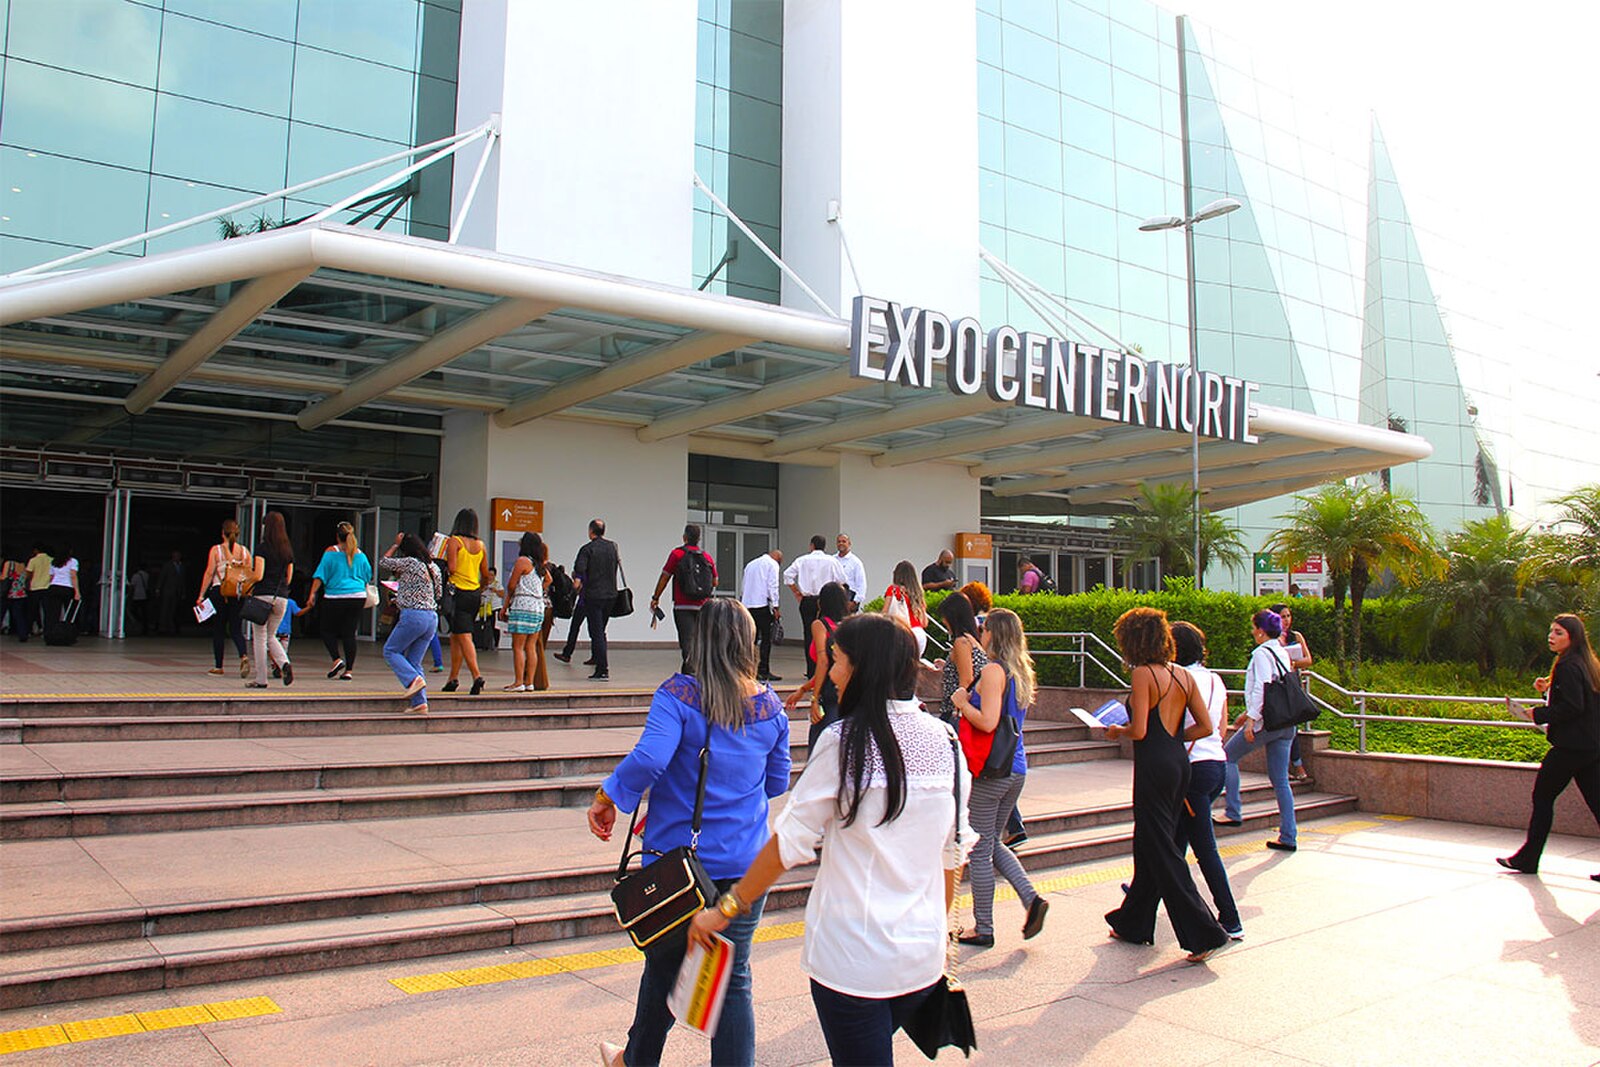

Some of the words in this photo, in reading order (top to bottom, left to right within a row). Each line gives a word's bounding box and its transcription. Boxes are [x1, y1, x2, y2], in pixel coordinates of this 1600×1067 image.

[853, 296, 983, 394] EXPO
[987, 325, 1146, 426] CENTER
[1147, 361, 1260, 444] NORTE
